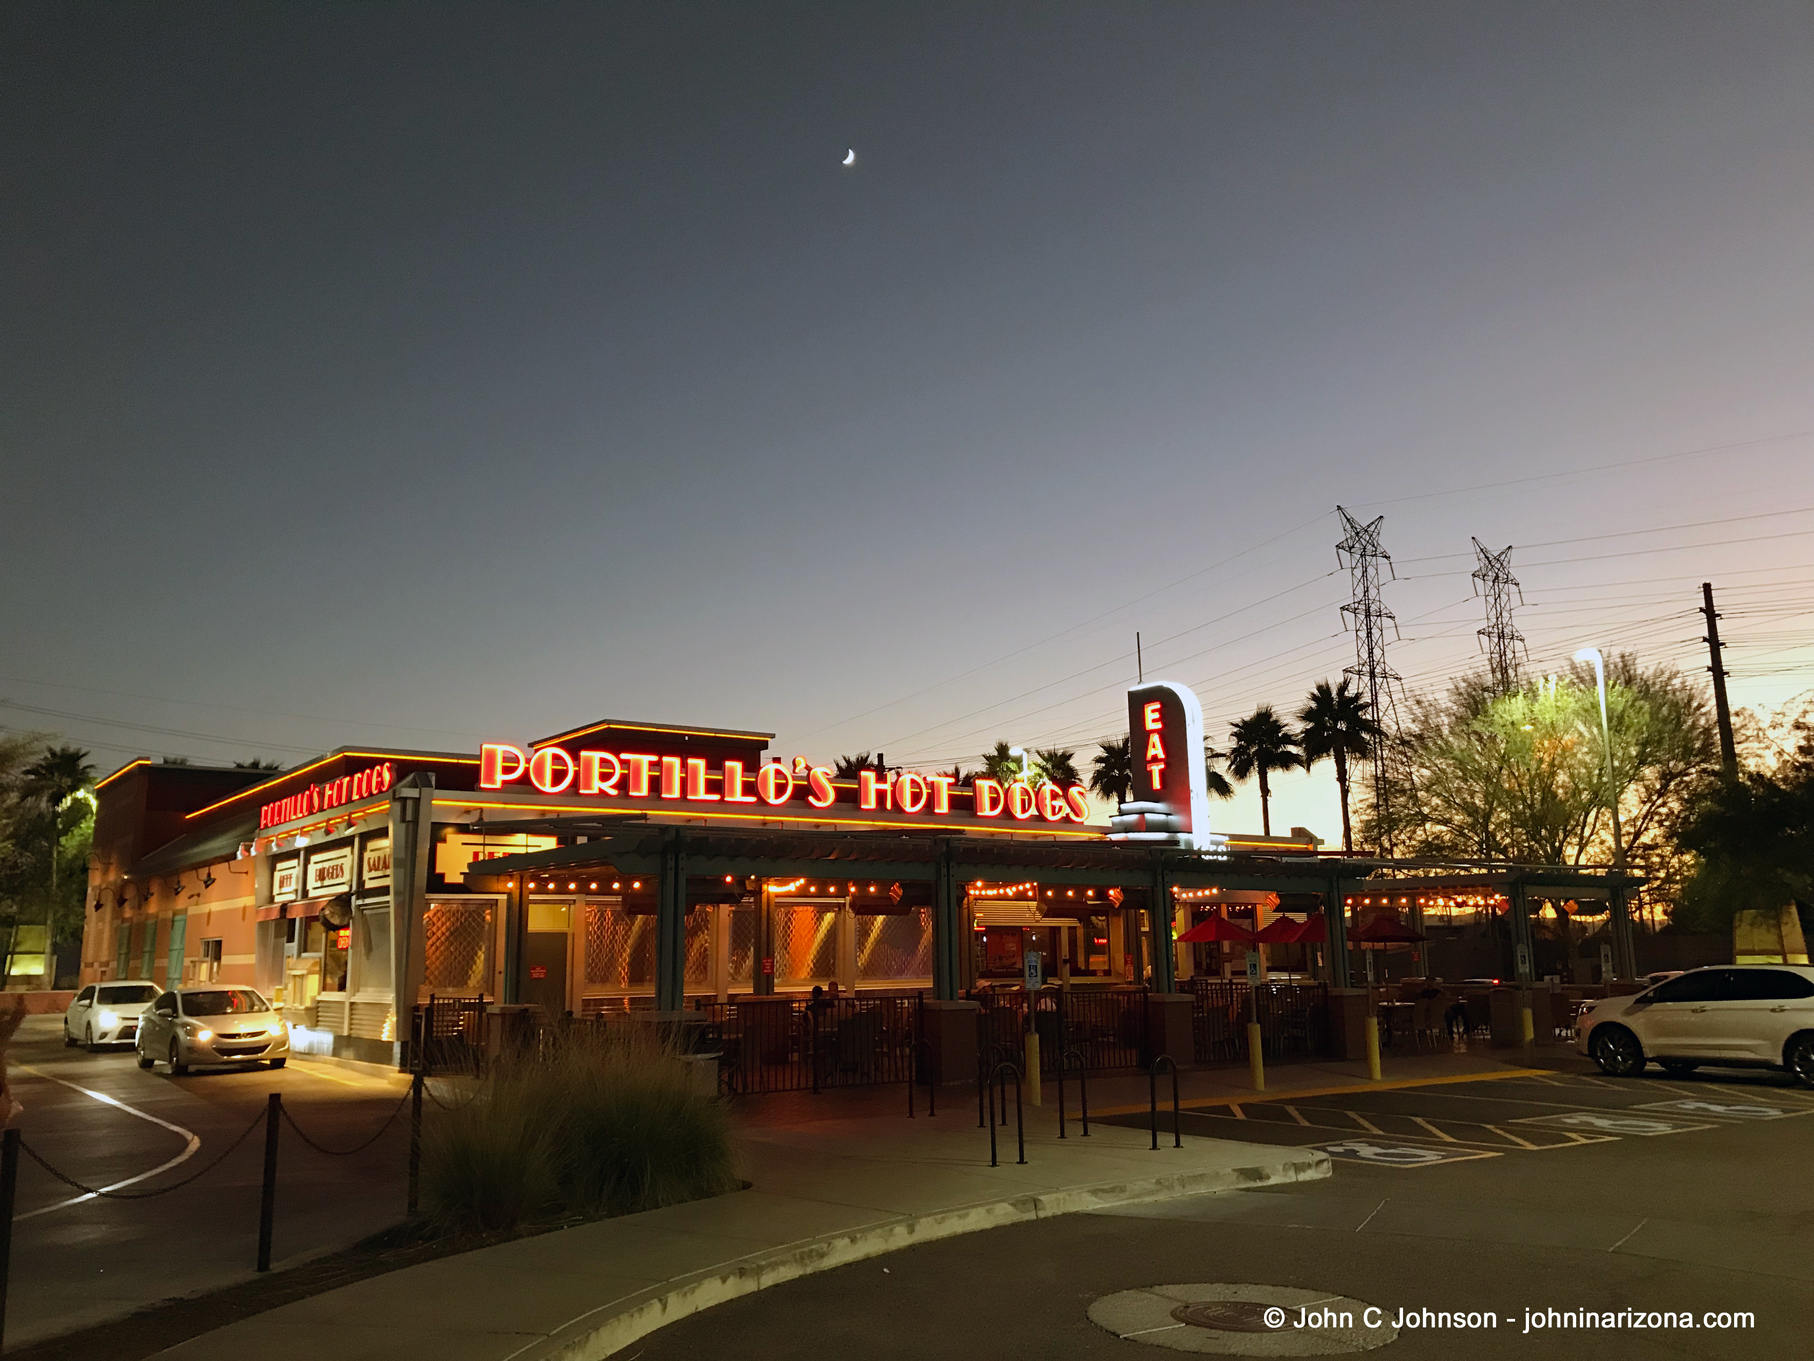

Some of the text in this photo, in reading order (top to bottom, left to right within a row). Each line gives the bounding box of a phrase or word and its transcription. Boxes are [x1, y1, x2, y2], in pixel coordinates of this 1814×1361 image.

[479, 742, 1091, 823] PORTILLO'S HOT DOGS
[1144, 701, 1165, 790] EAT
[260, 762, 392, 830] PORTILLO'S HOT DOGS
